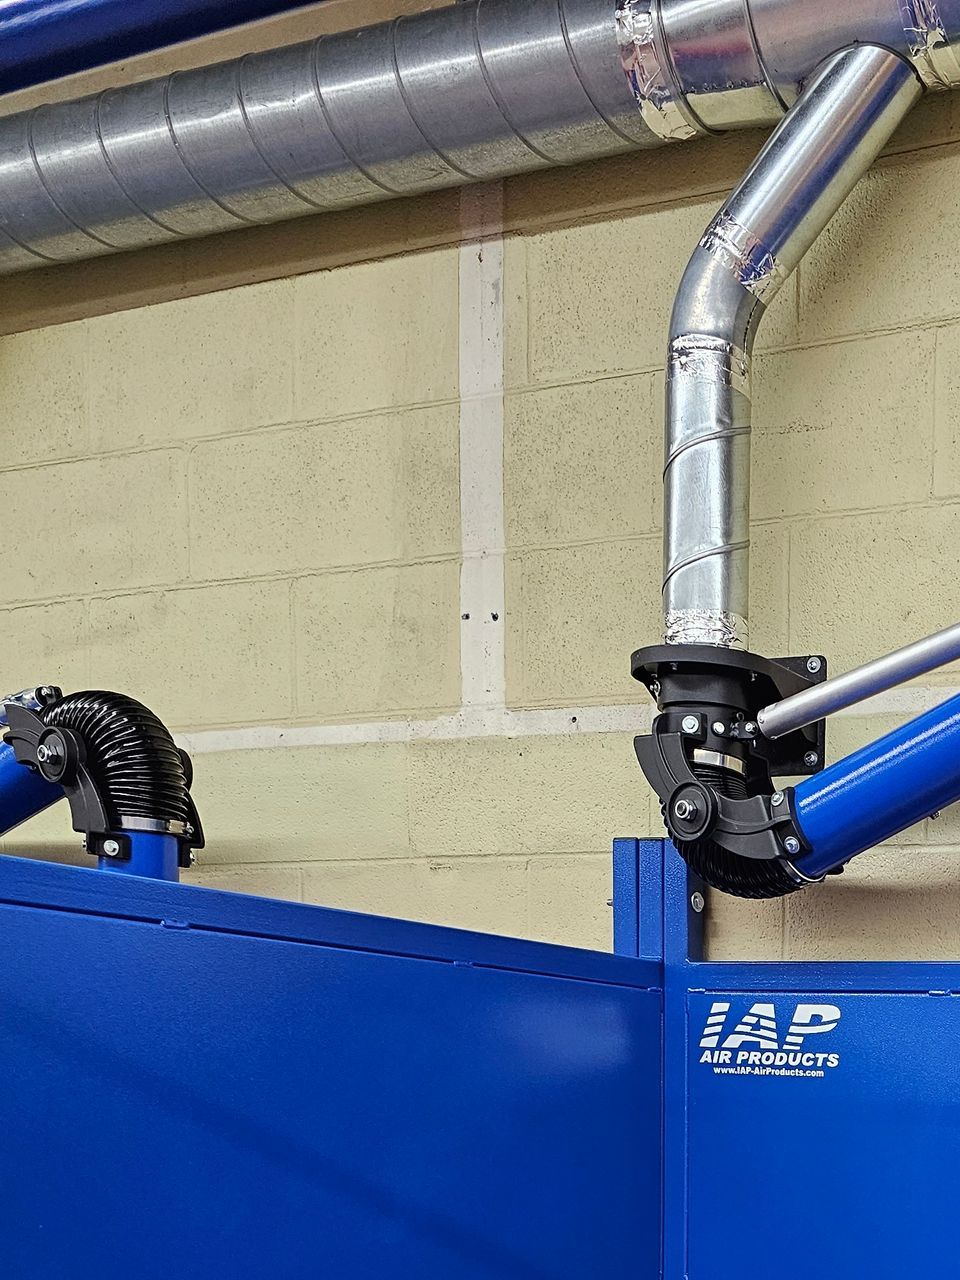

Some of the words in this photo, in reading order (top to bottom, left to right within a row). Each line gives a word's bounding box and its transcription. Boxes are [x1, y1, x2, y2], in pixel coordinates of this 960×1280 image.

[699, 1002, 841, 1050] IAP
[699, 1050, 732, 1064] AIR
[736, 1051, 840, 1068] PRODUCTS
[713, 1066, 824, 1078] www.IAP-AirProducts.com
